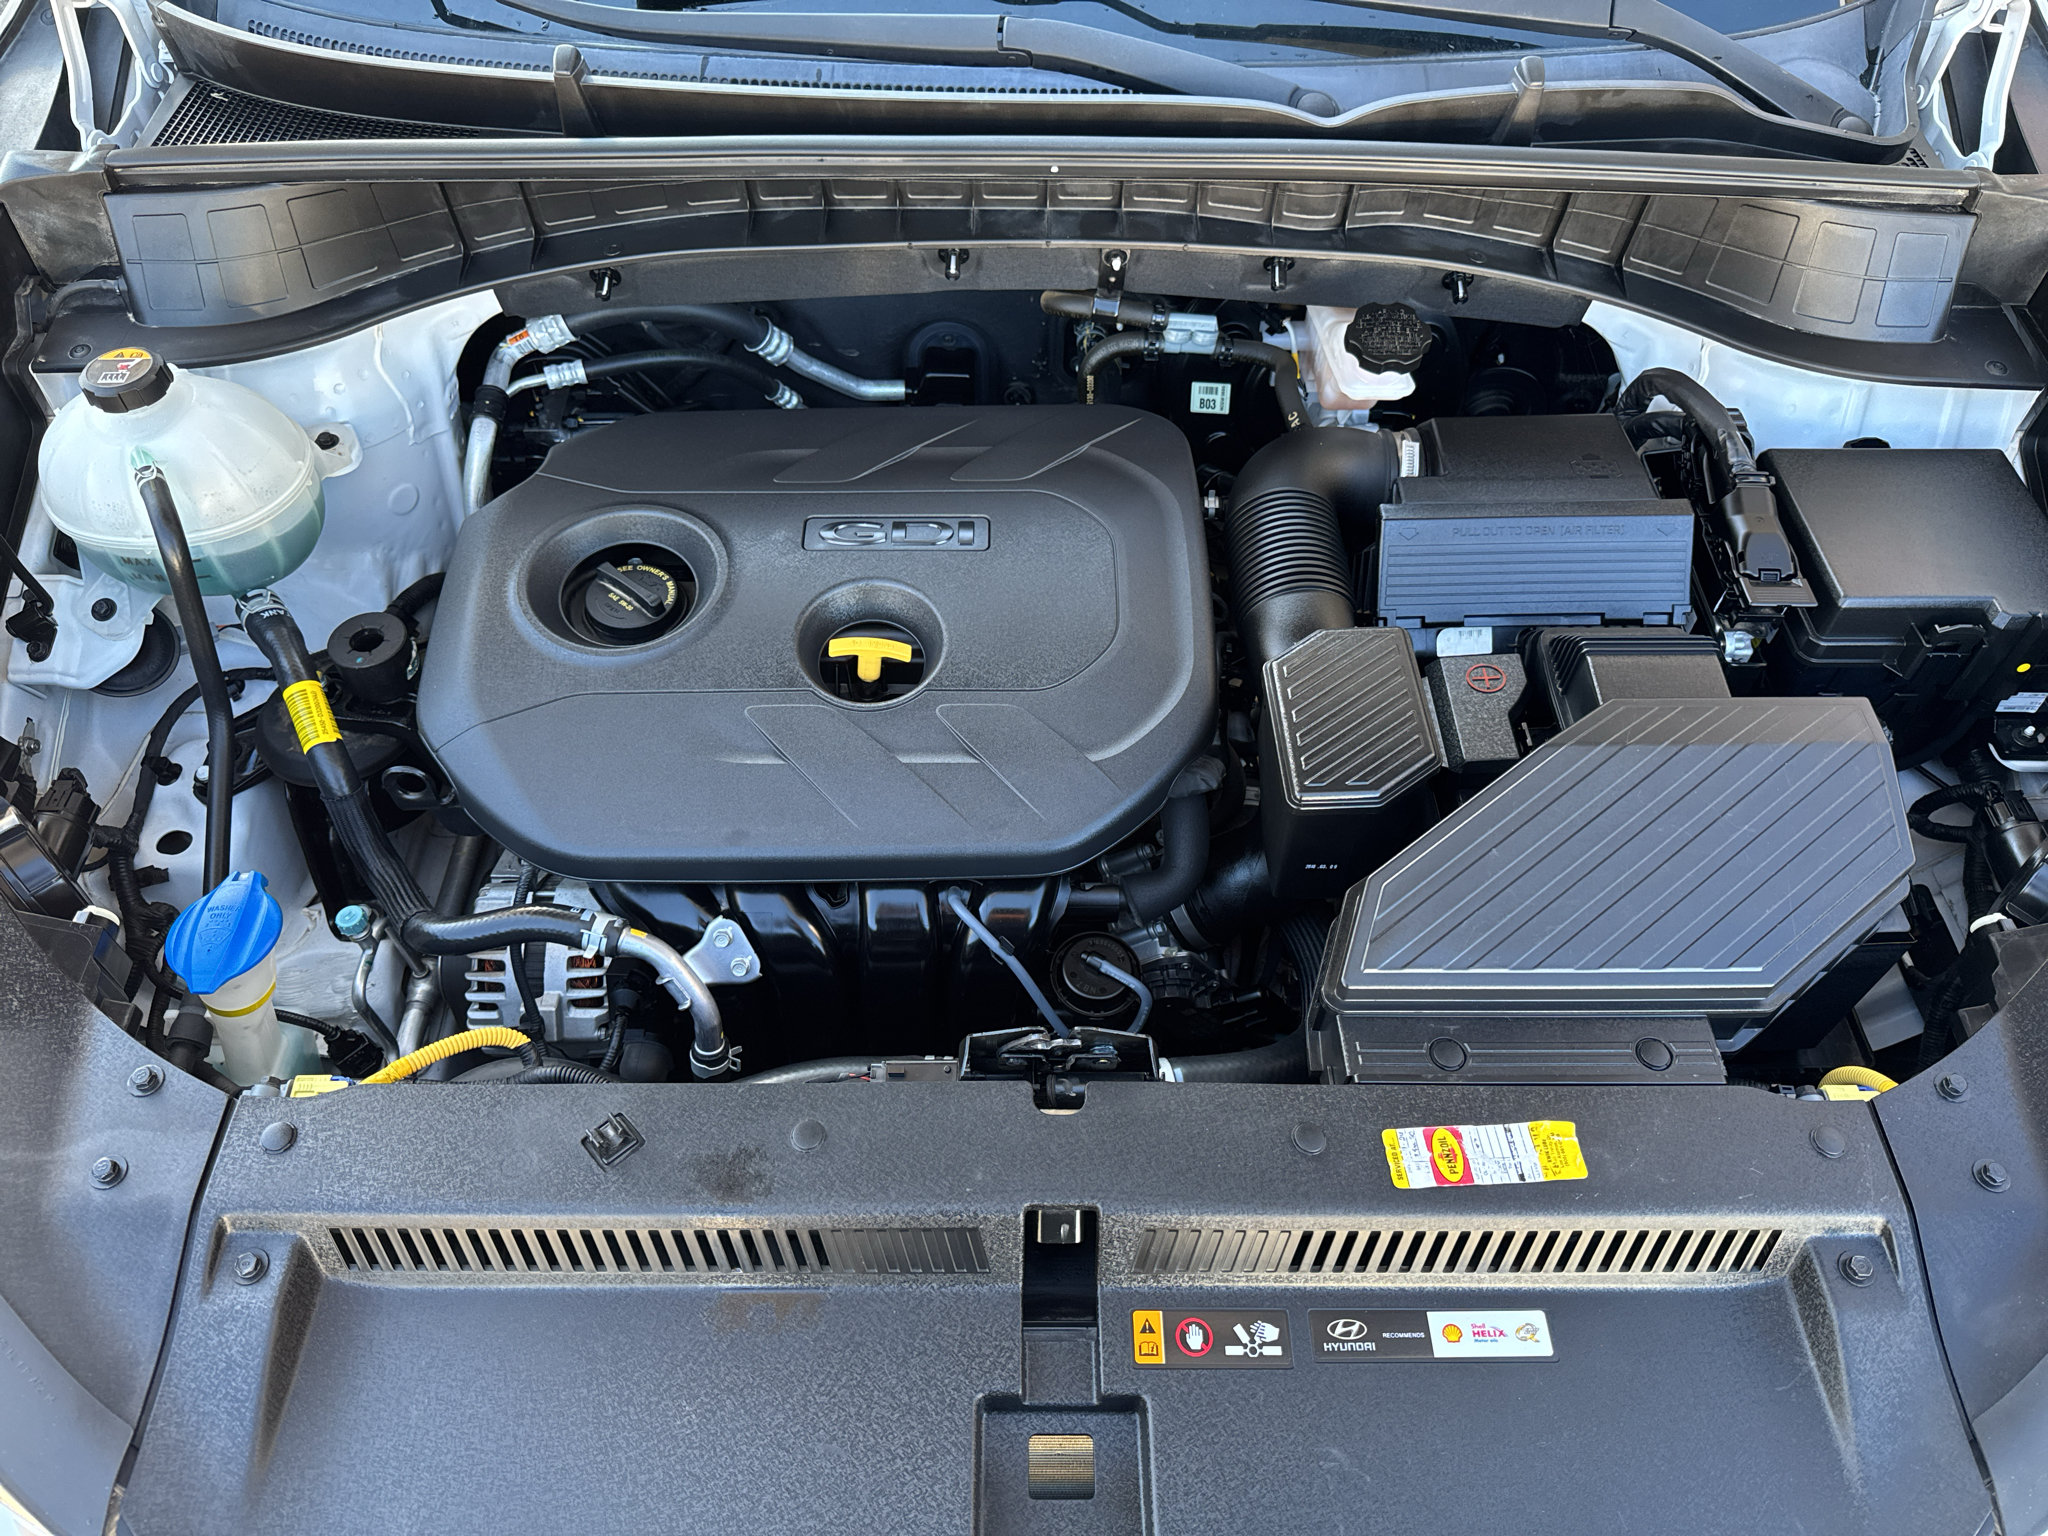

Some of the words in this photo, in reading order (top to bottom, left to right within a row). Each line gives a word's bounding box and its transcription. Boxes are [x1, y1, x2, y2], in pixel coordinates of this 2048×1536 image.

[1199, 398, 1217, 410] B03
[819, 520, 976, 546] GDI
[1452, 527, 1480, 537] PULL
[1482, 526, 1505, 537] OUT
[1507, 525, 1523, 536] TO
[1525, 524, 1556, 536] OPEN
[120, 556, 154, 567] MAX
[207, 904, 242, 913] WASHER
[209, 912, 231, 920] ONLY
[1437, 1136, 1459, 1175] PENNZOIL
[1391, 1152, 1404, 1181] SERVICED
[1470, 1322, 1486, 1330] Shell
[1472, 1330, 1506, 1338] HELIX
[1323, 1342, 1376, 1352] HYUNDAI
